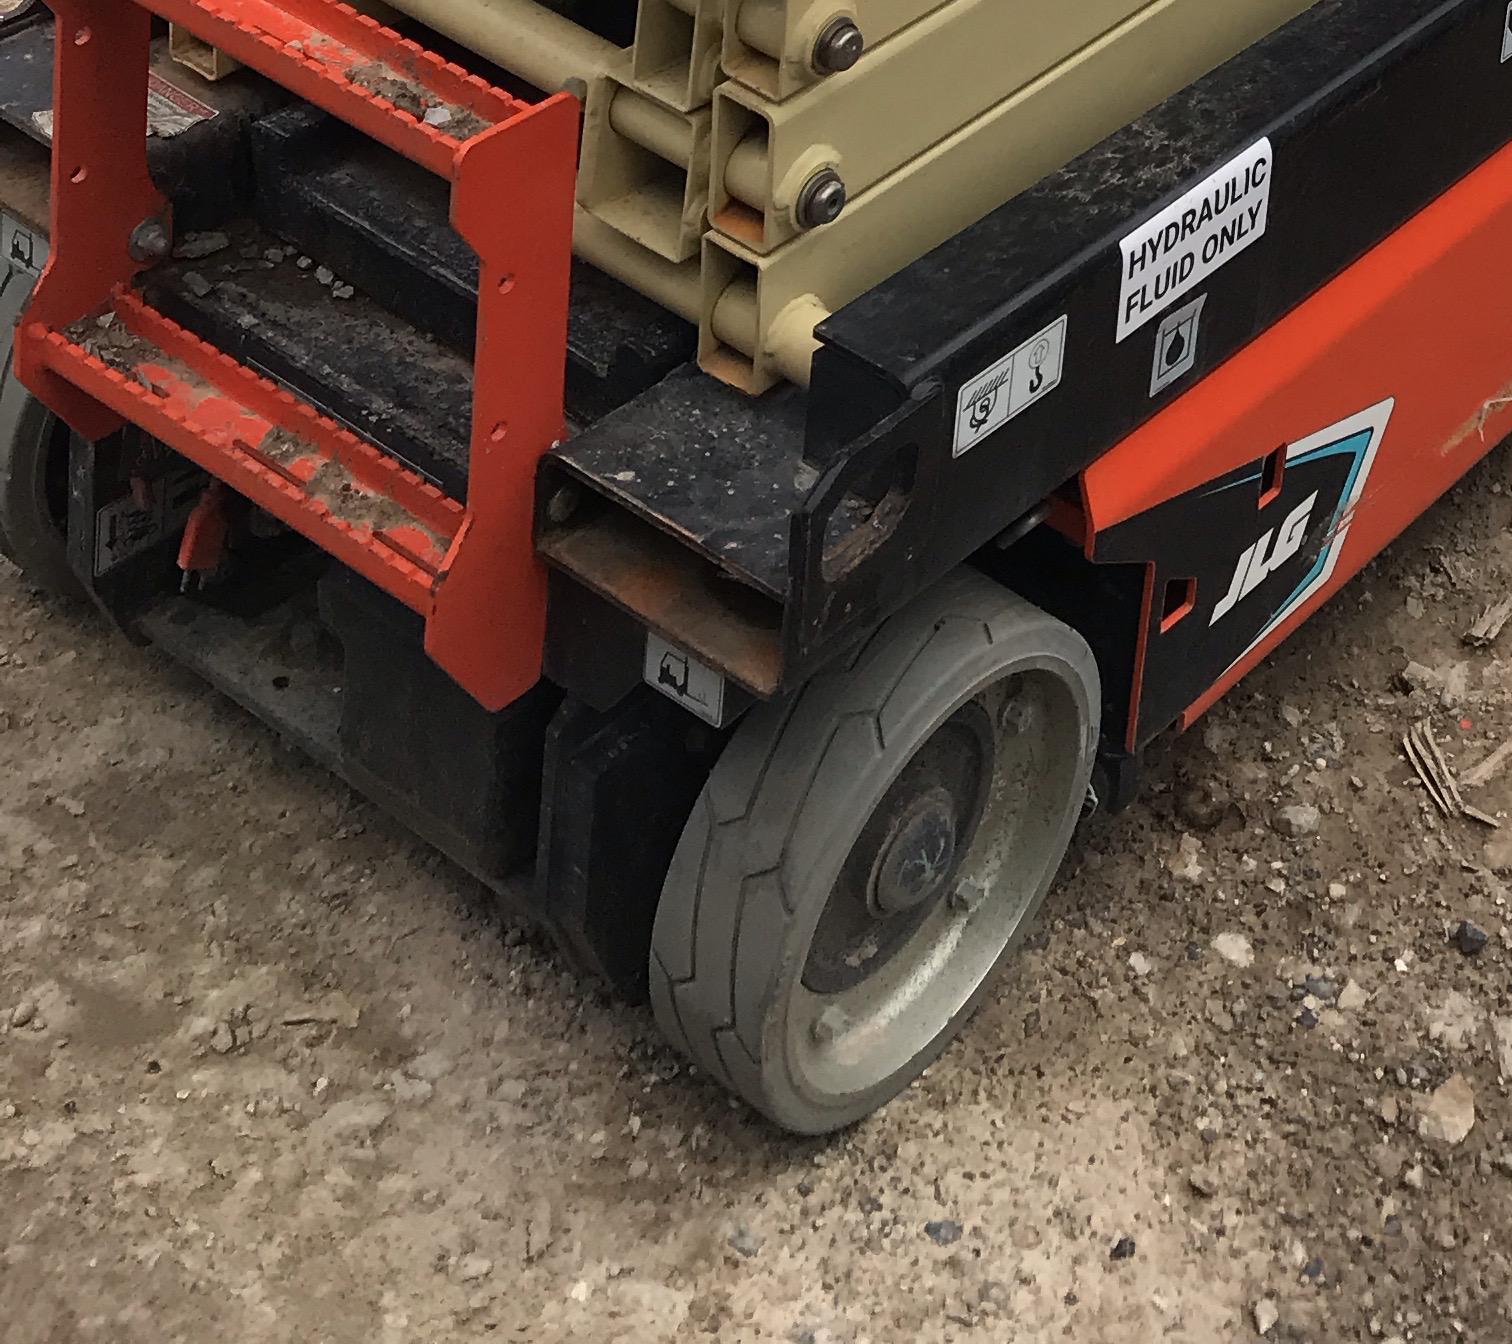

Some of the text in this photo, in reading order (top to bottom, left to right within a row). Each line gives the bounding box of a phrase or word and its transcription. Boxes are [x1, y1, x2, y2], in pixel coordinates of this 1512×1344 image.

[1125, 198, 1264, 325] FLUID ONLY
[1128, 157, 1268, 280] HYDRAULIC
[1209, 489, 1319, 628] JLG
